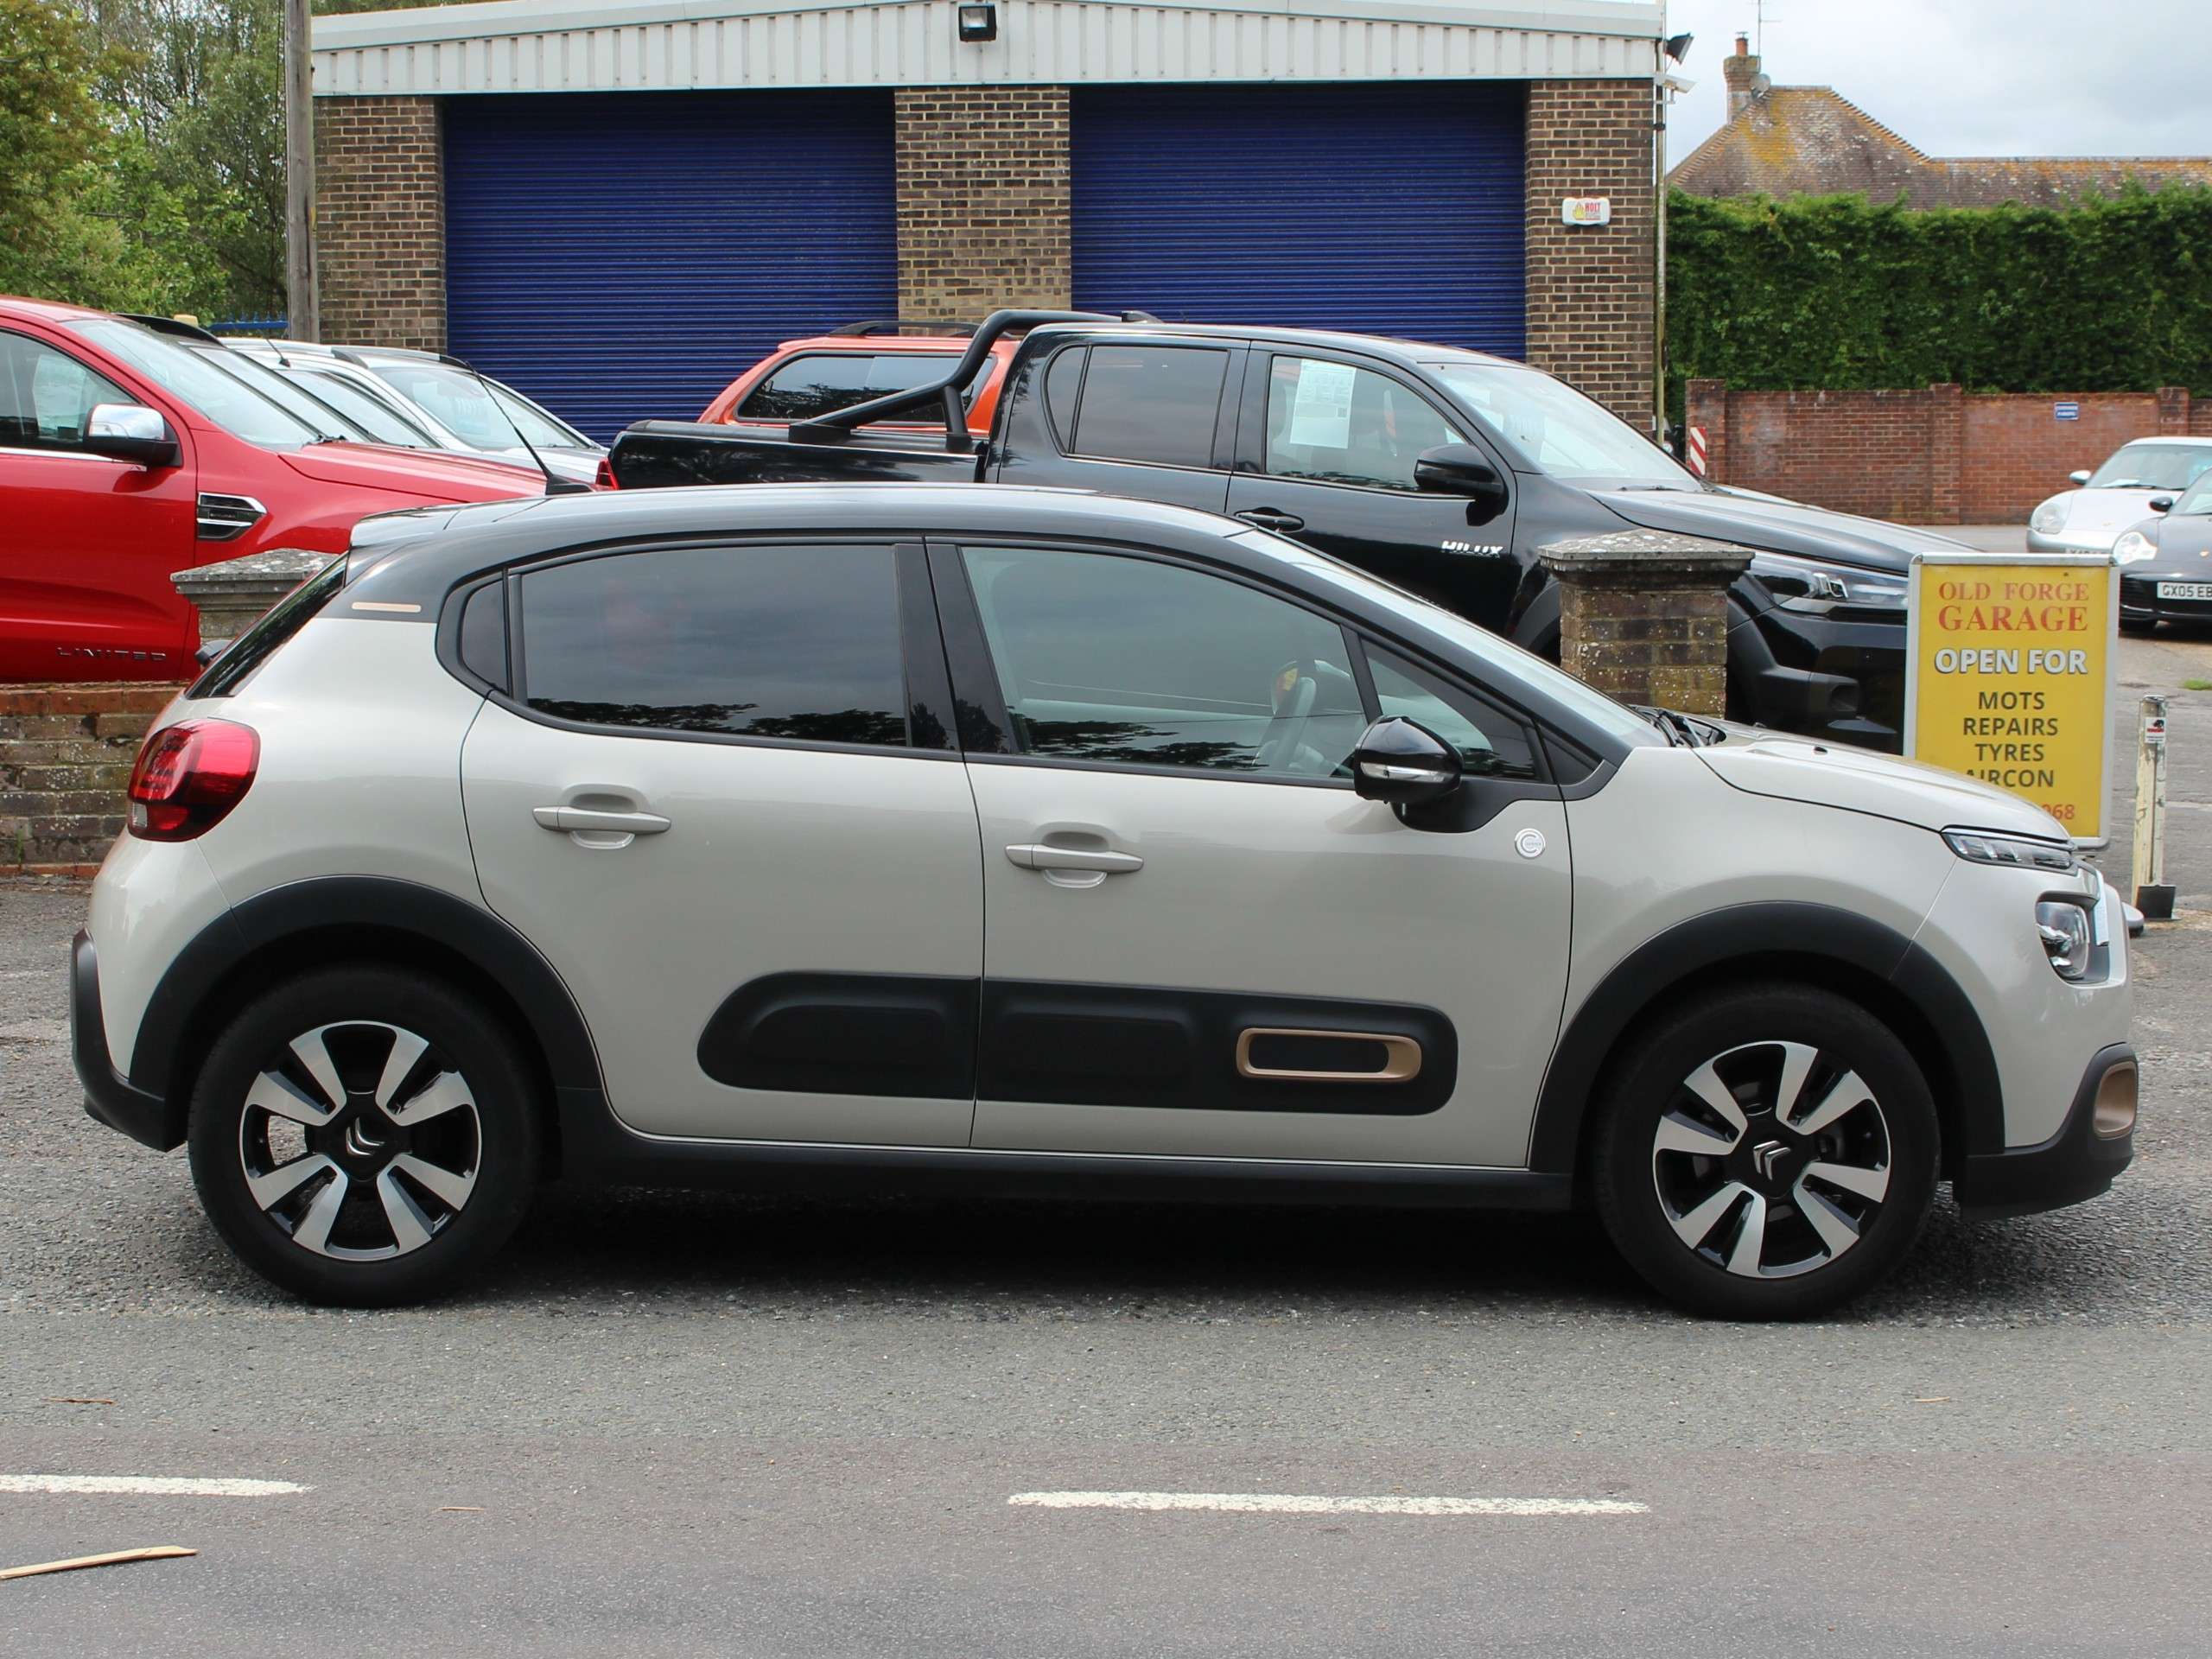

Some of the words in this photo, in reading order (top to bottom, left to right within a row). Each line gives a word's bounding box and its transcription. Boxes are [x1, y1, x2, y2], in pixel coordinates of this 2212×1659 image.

[1440, 540, 1503, 557] HILUX
[1938, 582, 1992, 601] OLD
[2004, 582, 2089, 601] FORGE
[2163, 585, 2194, 597] GX05
[1938, 606, 2088, 632] GARAGE
[56, 646, 166, 661] LIMITED
[1935, 648, 2019, 674] OPEN
[2027, 649, 2088, 674] FOR
[1978, 691, 2045, 710] MOTS
[1962, 717, 2059, 736] REPAIRS
[1974, 743, 2044, 761] TYRES
